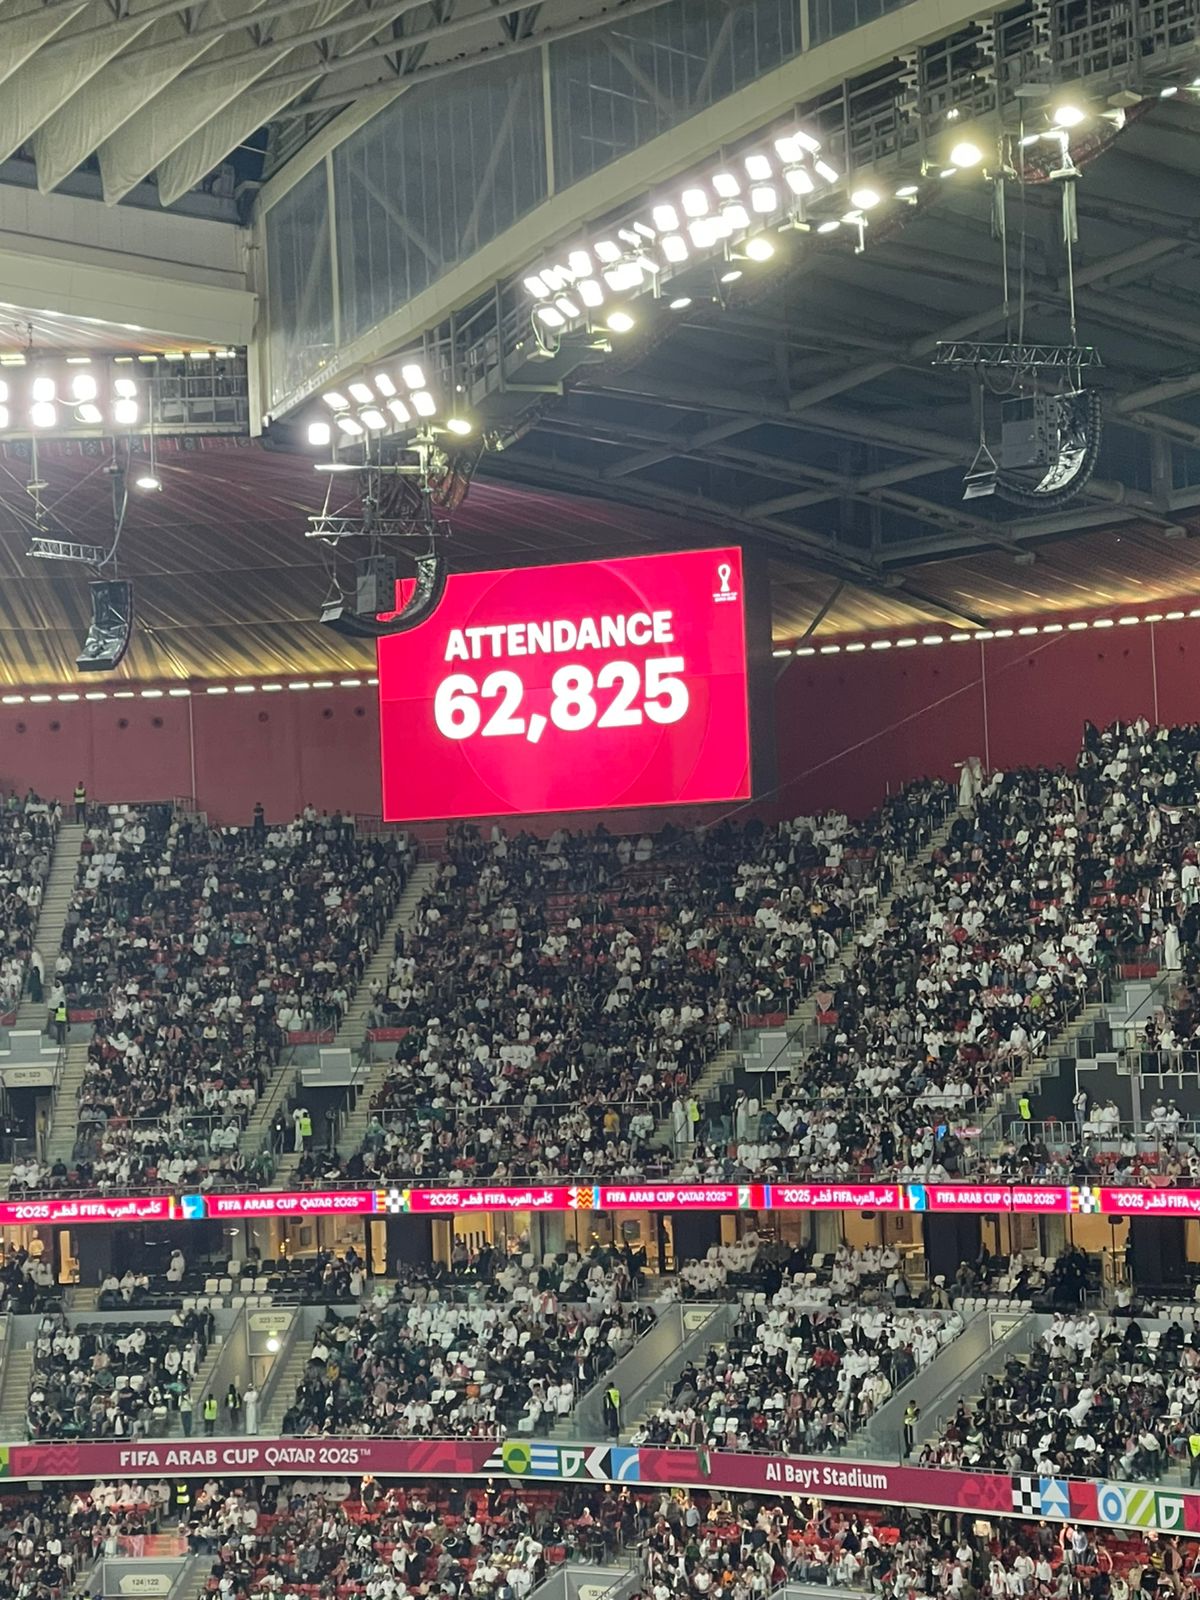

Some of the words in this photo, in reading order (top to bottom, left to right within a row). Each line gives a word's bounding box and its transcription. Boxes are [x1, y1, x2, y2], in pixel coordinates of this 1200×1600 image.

[445, 611, 674, 662] ATTENDANCE
[435, 657, 689, 743] 62,825
[461, 1192, 483, 1207] قطر
[484, 1194, 507, 1204] FIFA
[607, 1192, 627, 1202] FIFA
[629, 1192, 654, 1202] ARAB
[657, 1192, 675, 1202] CUP
[677, 1192, 705, 1203] QATAR
[812, 1189, 832, 1204] قطر
[833, 1191, 853, 1202] FIFA
[937, 1192, 956, 1202] FIFA
[957, 1192, 982, 1203] ARAB
[984, 1193, 1001, 1203] CUP
[1168, 1196, 1189, 1207] FIFA
[80, 1204, 106, 1215] FIFA
[218, 1200, 241, 1210] FIFA
[244, 1199, 274, 1209] ARAB
[276, 1198, 298, 1209] CUP
[300, 1198, 332, 1210] QATAR
[51, 1203, 78, 1219] قطر
[121, 1451, 159, 1466] FIFA
[166, 1450, 217, 1465] ARAB
[223, 1449, 258, 1463] CUP
[265, 1448, 315, 1466] QATAR
[766, 1462, 781, 1481] Al
[785, 1464, 820, 1488] Bayt
[823, 1467, 888, 1490] Stadium
